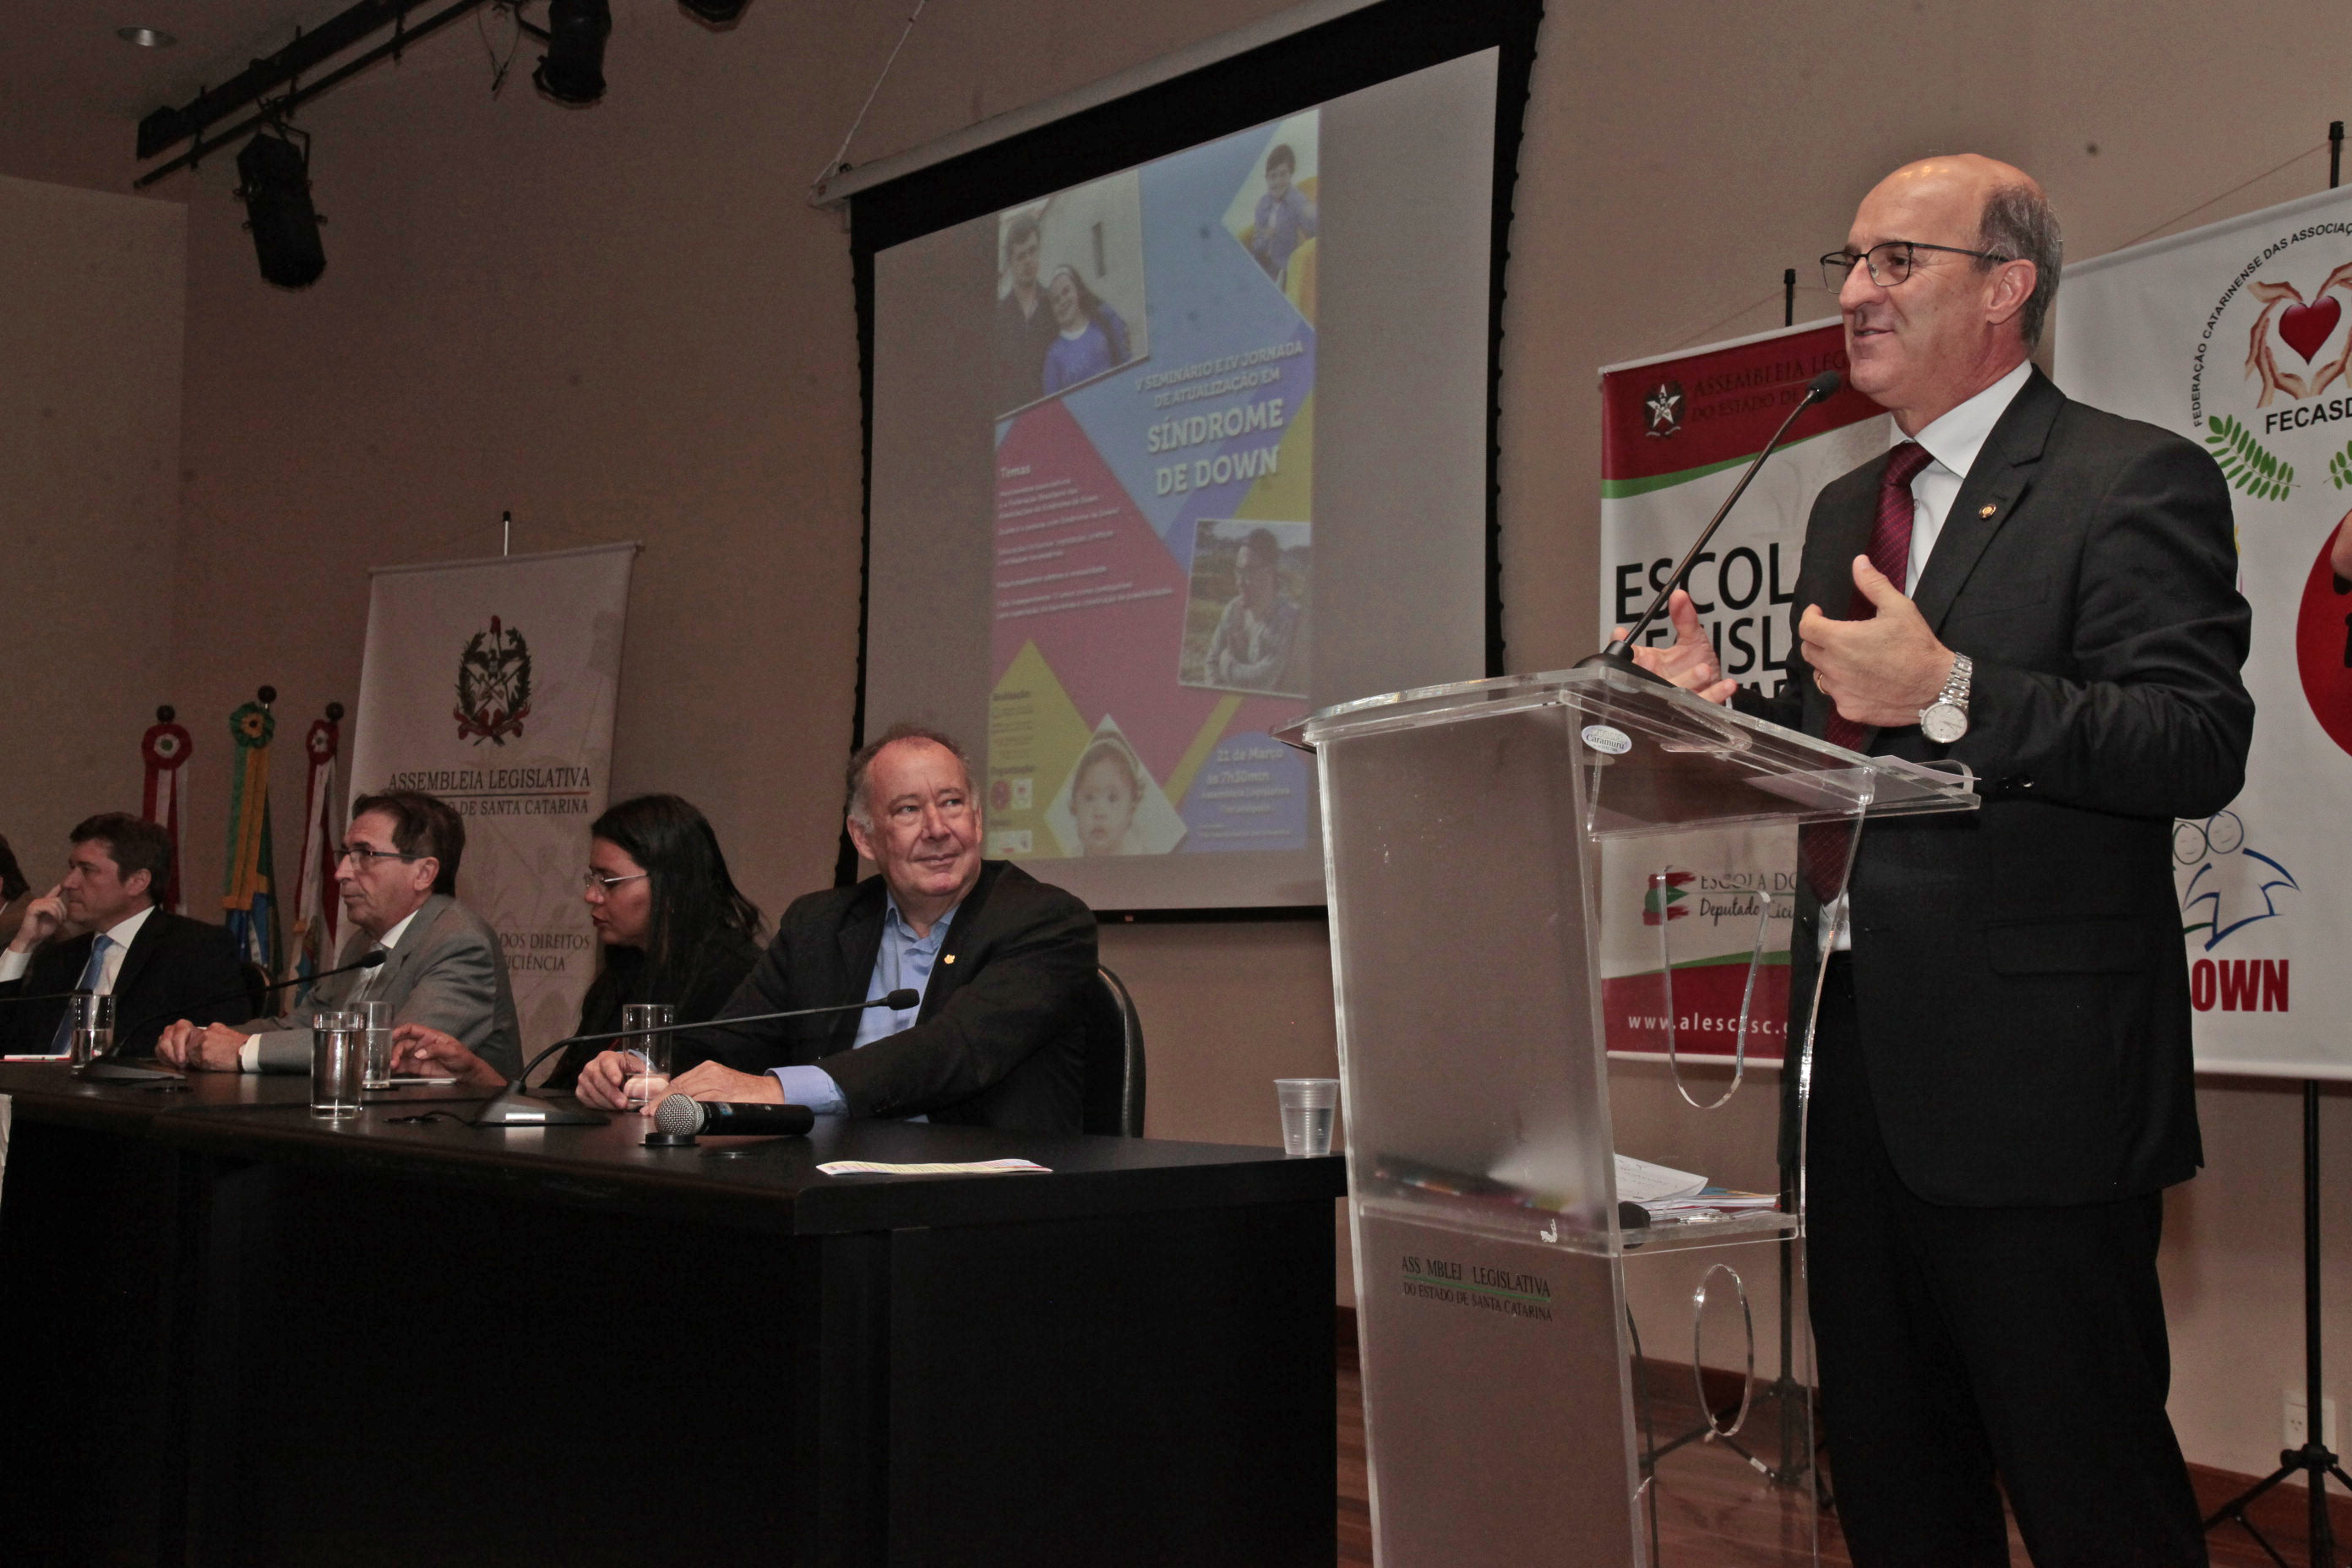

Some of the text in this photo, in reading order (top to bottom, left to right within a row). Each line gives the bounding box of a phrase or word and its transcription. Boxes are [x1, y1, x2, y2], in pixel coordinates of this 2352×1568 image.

[2191, 343, 2207, 427] FEDERAÇÃO
[2202, 256, 2262, 339] CATARINENSE
[2263, 238, 2289, 260] DAS
[1239, 340, 1303, 367] JORNADA
[1155, 394, 1170, 410] DE
[1260, 367, 1281, 384] EM
[1148, 398, 1283, 454] SÍNDROME
[1157, 445, 1279, 496] DE DOWN
[1616, 542, 1794, 623] ESCOL
[389, 767, 590, 791] ASSEMBLEIA LEGISLATIVA
[460, 801, 476, 815] DE
[480, 799, 520, 815] SANTA
[525, 798, 589, 814] CATARINA
[1700, 895, 1759, 927] Deputado
[500, 933, 591, 950] DOS DIREITOS
[504, 953, 565, 972] ICIÊNCIA
[2191, 958, 2289, 1012] OWN
[1473, 1266, 1551, 1297] LEGISLATIVA
[1403, 1282, 1553, 1322] DO ESTADO DE SANTA CATARINA
